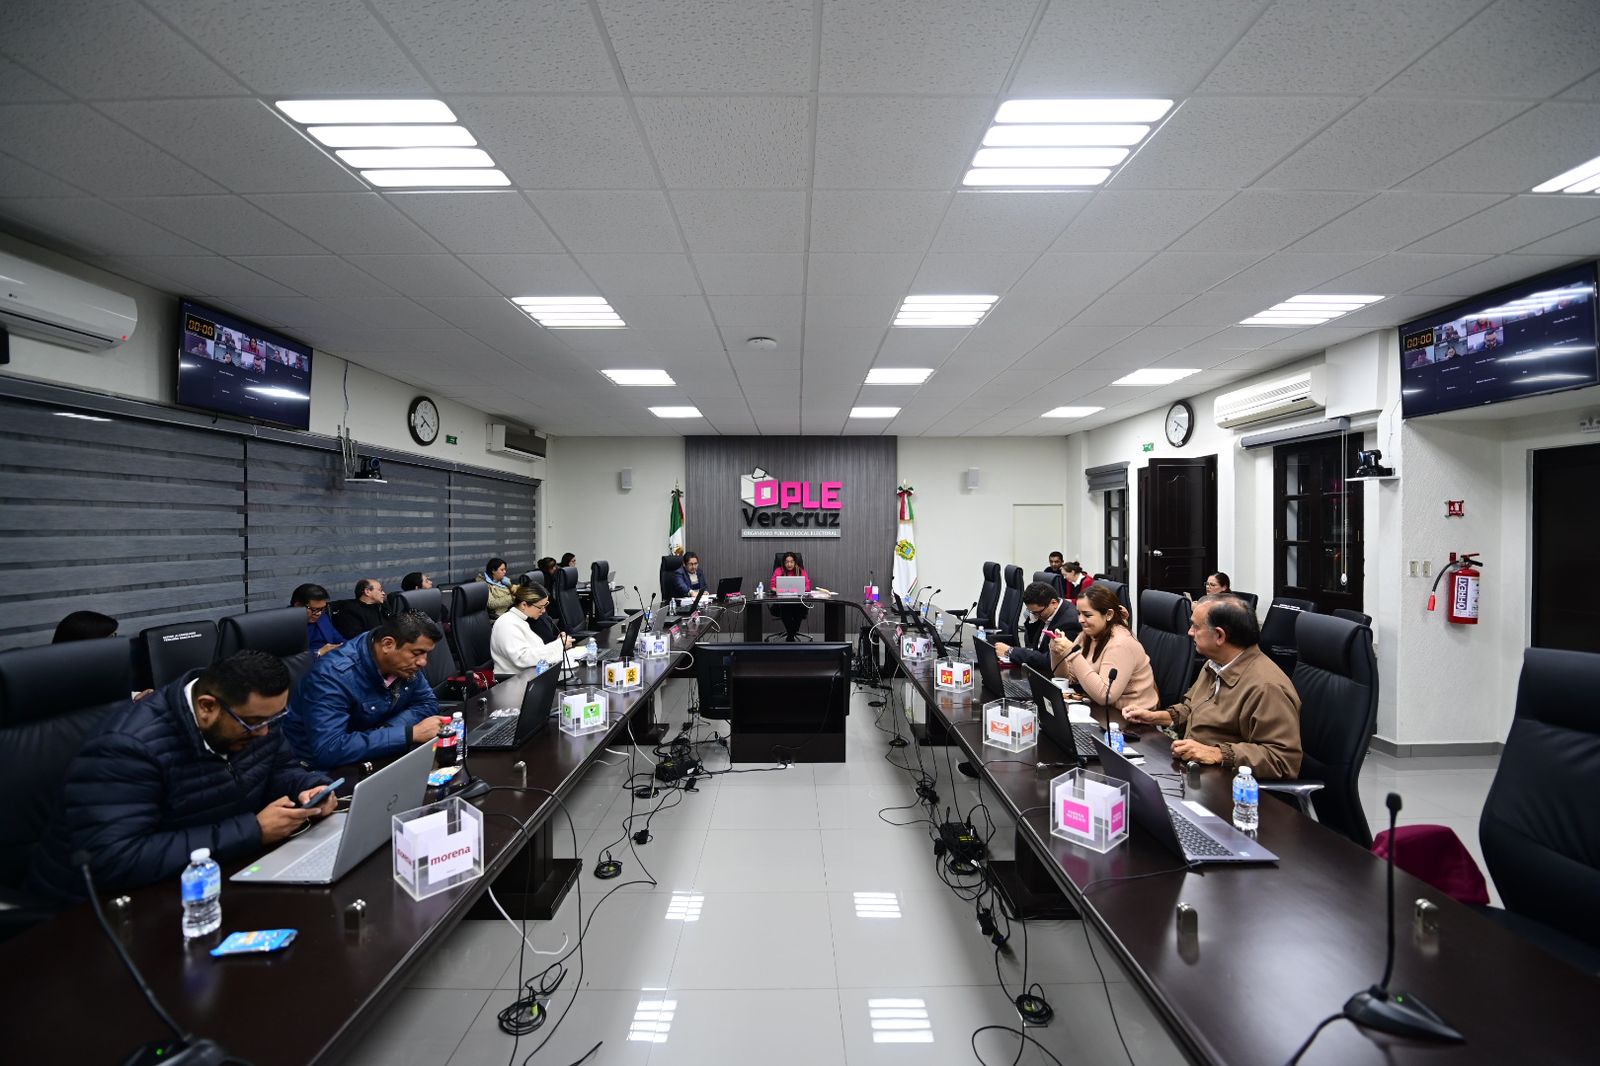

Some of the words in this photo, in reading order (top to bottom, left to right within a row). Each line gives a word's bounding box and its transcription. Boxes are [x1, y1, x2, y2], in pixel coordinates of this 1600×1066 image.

[188, 319, 214, 337] 00:00
[1407, 333, 1432, 348] 00:00
[754, 479, 842, 509] OPLE
[742, 508, 840, 528] Veracruz
[941, 674, 953, 684] PT
[430, 846, 471, 867] morena
